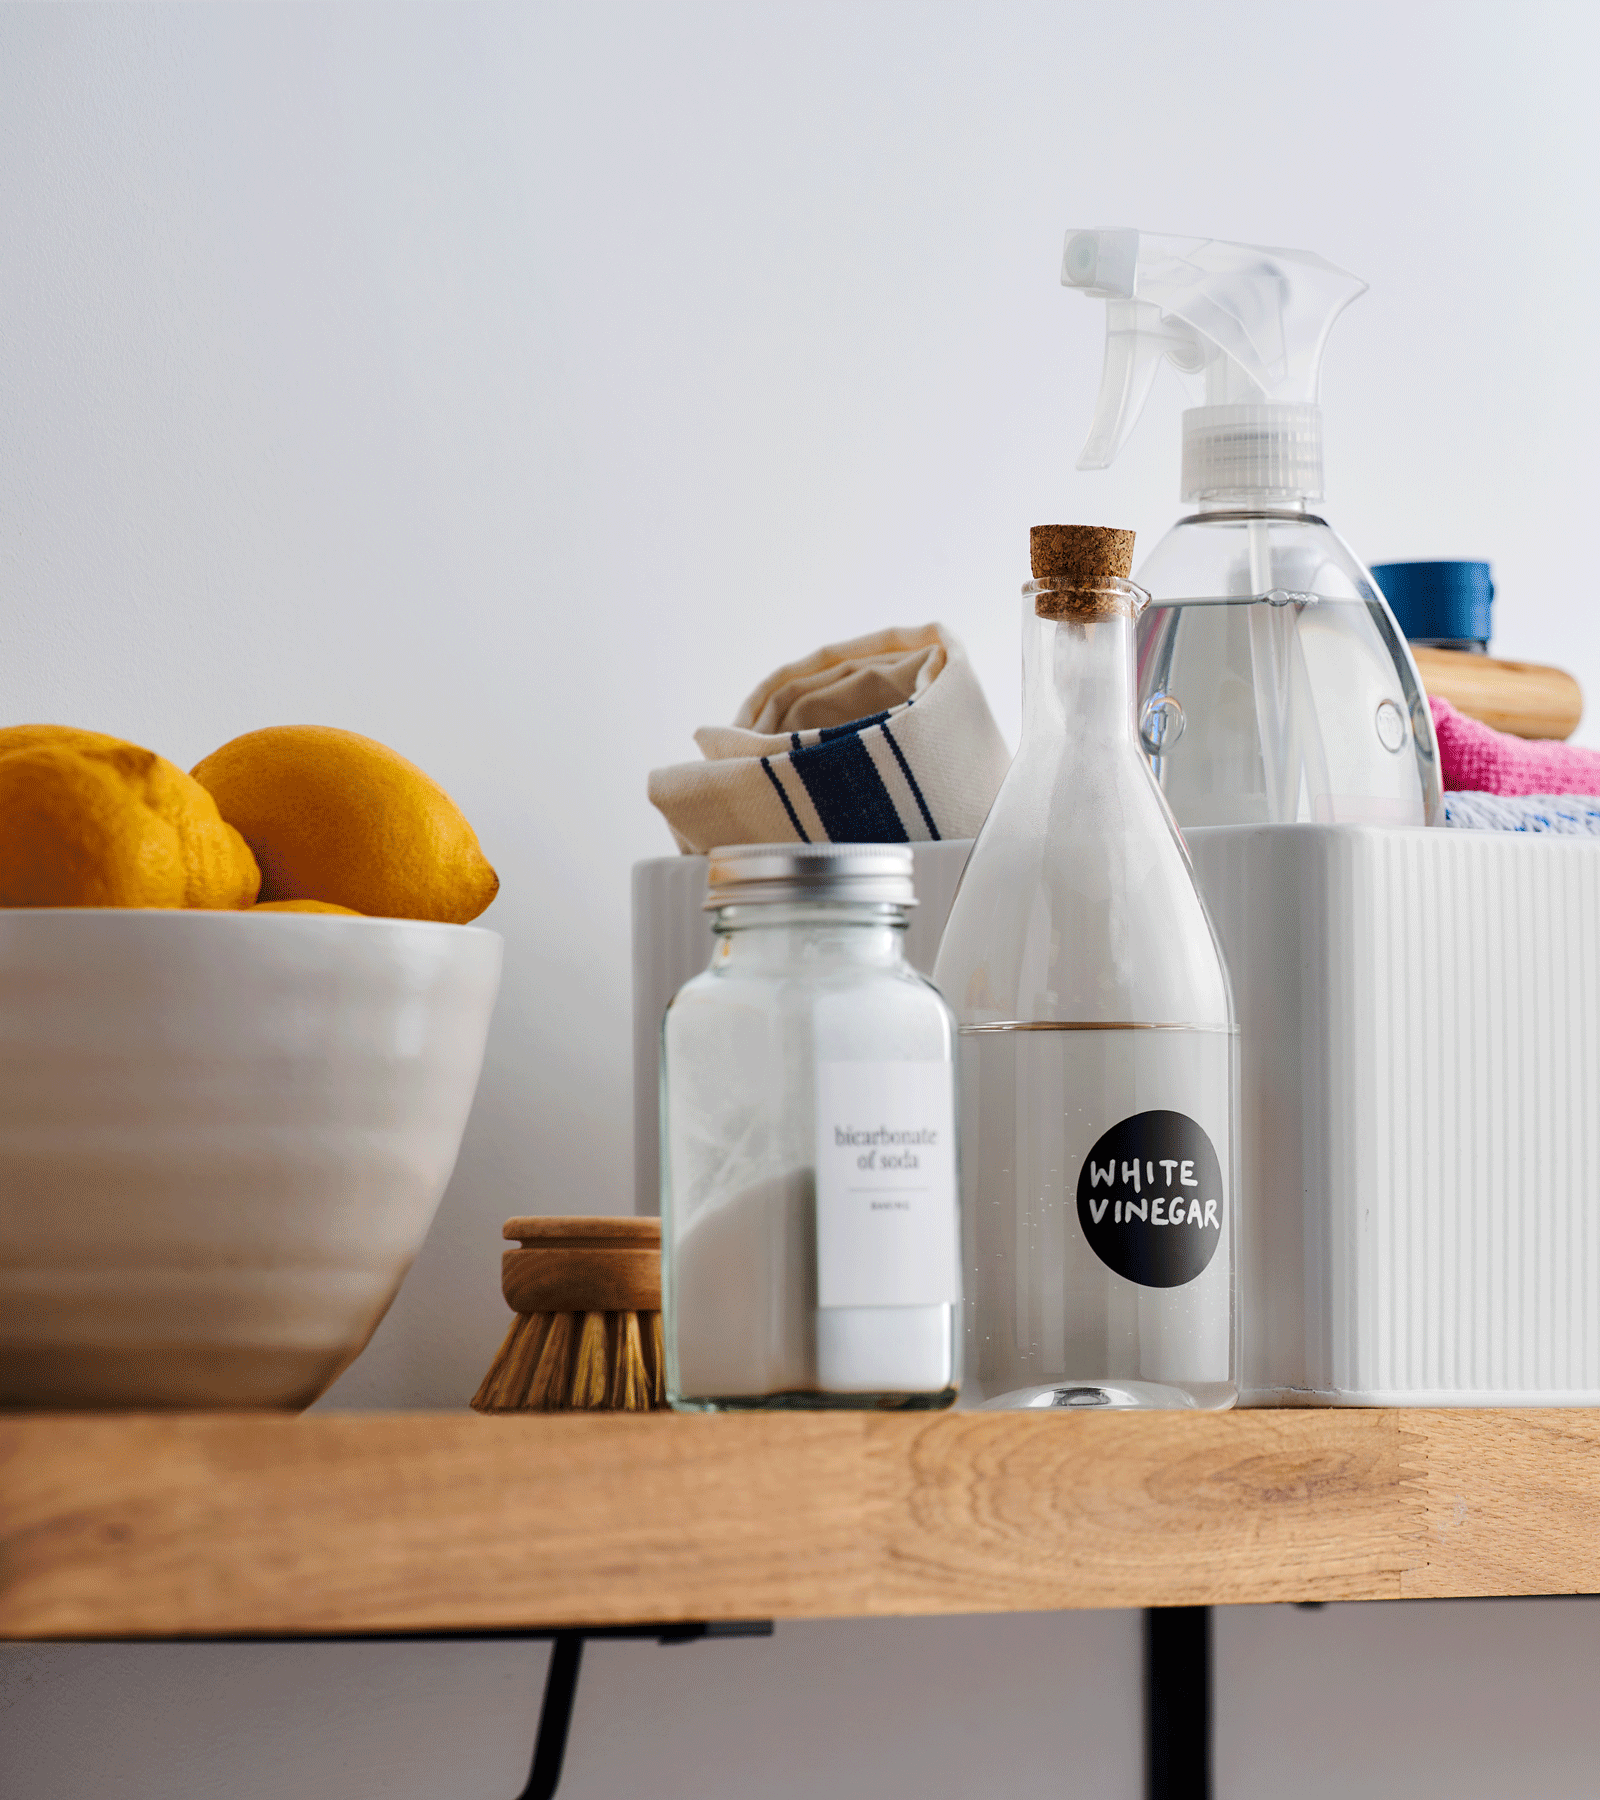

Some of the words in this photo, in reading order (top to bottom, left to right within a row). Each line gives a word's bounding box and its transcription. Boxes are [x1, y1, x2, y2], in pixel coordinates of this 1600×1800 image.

[834, 1124, 937, 1146] bicarbonate
[857, 1149, 876, 1171] of
[880, 1149, 918, 1170] soda
[1090, 1158, 1199, 1194] WHITE
[1089, 1197, 1220, 1230] VINEGAR
